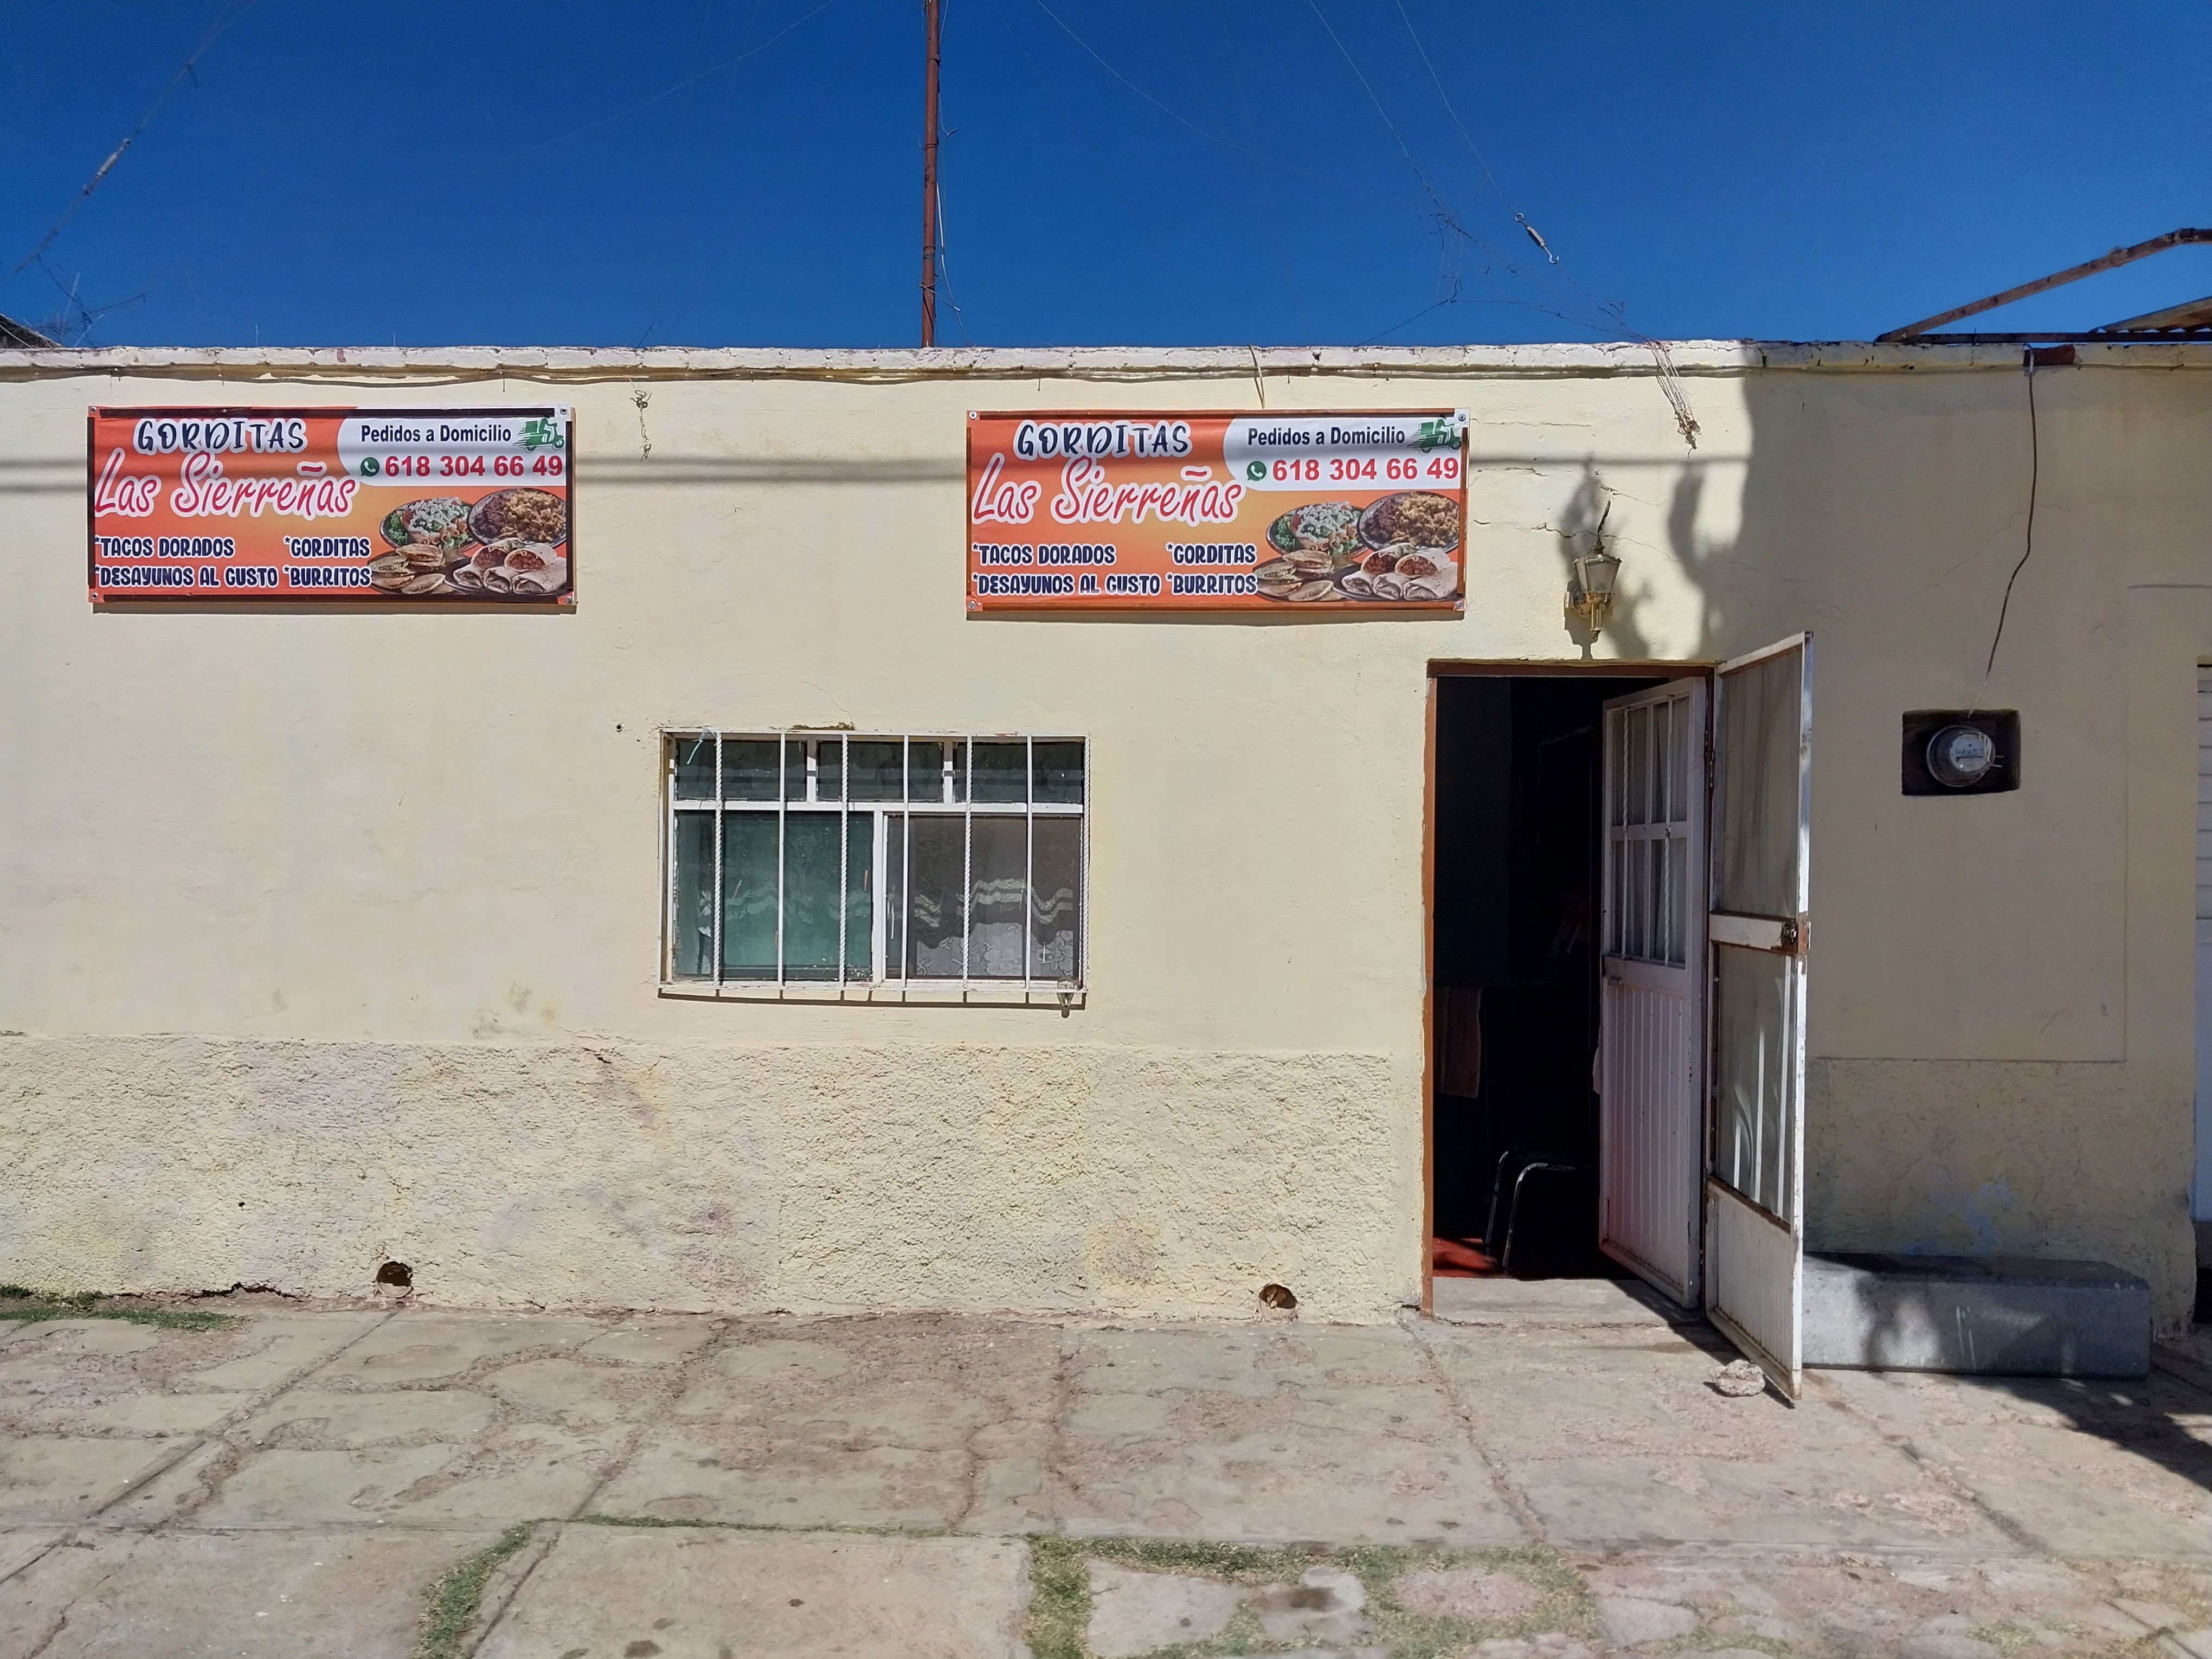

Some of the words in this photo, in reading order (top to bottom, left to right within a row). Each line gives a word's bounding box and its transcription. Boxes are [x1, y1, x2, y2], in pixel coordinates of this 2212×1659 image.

[138, 421, 304, 451] GORDITAS
[361, 425, 420, 442] Pedidos
[426, 429, 434, 442] a
[440, 425, 511, 442] Domicilio
[1018, 425, 1188, 456] GORDITAS
[1248, 427, 1310, 445] Pedidos
[1316, 432, 1324, 445] a
[1331, 426, 1405, 445] Domicilio
[385, 455, 430, 477] 618
[440, 455, 485, 477] 304
[494, 455, 524, 476] 66
[532, 455, 562, 476] 49
[1272, 459, 1319, 481] 618
[1329, 459, 1377, 480] 304
[1386, 458, 1417, 479] 66
[1427, 458, 1458, 479] 49
[95, 452, 157, 513] Las
[175, 451, 356, 516] Sierreñas
[974, 458, 1037, 519] Las
[1055, 458, 1241, 521] Sierreñas
[159, 538, 234, 557] DORADOS
[1039, 545, 1115, 564] DORADOS
[200, 568, 219, 586] AL
[226, 568, 278, 586] GUSTO
[1080, 575, 1099, 594] AL
[1107, 575, 1160, 594] GUSTO
